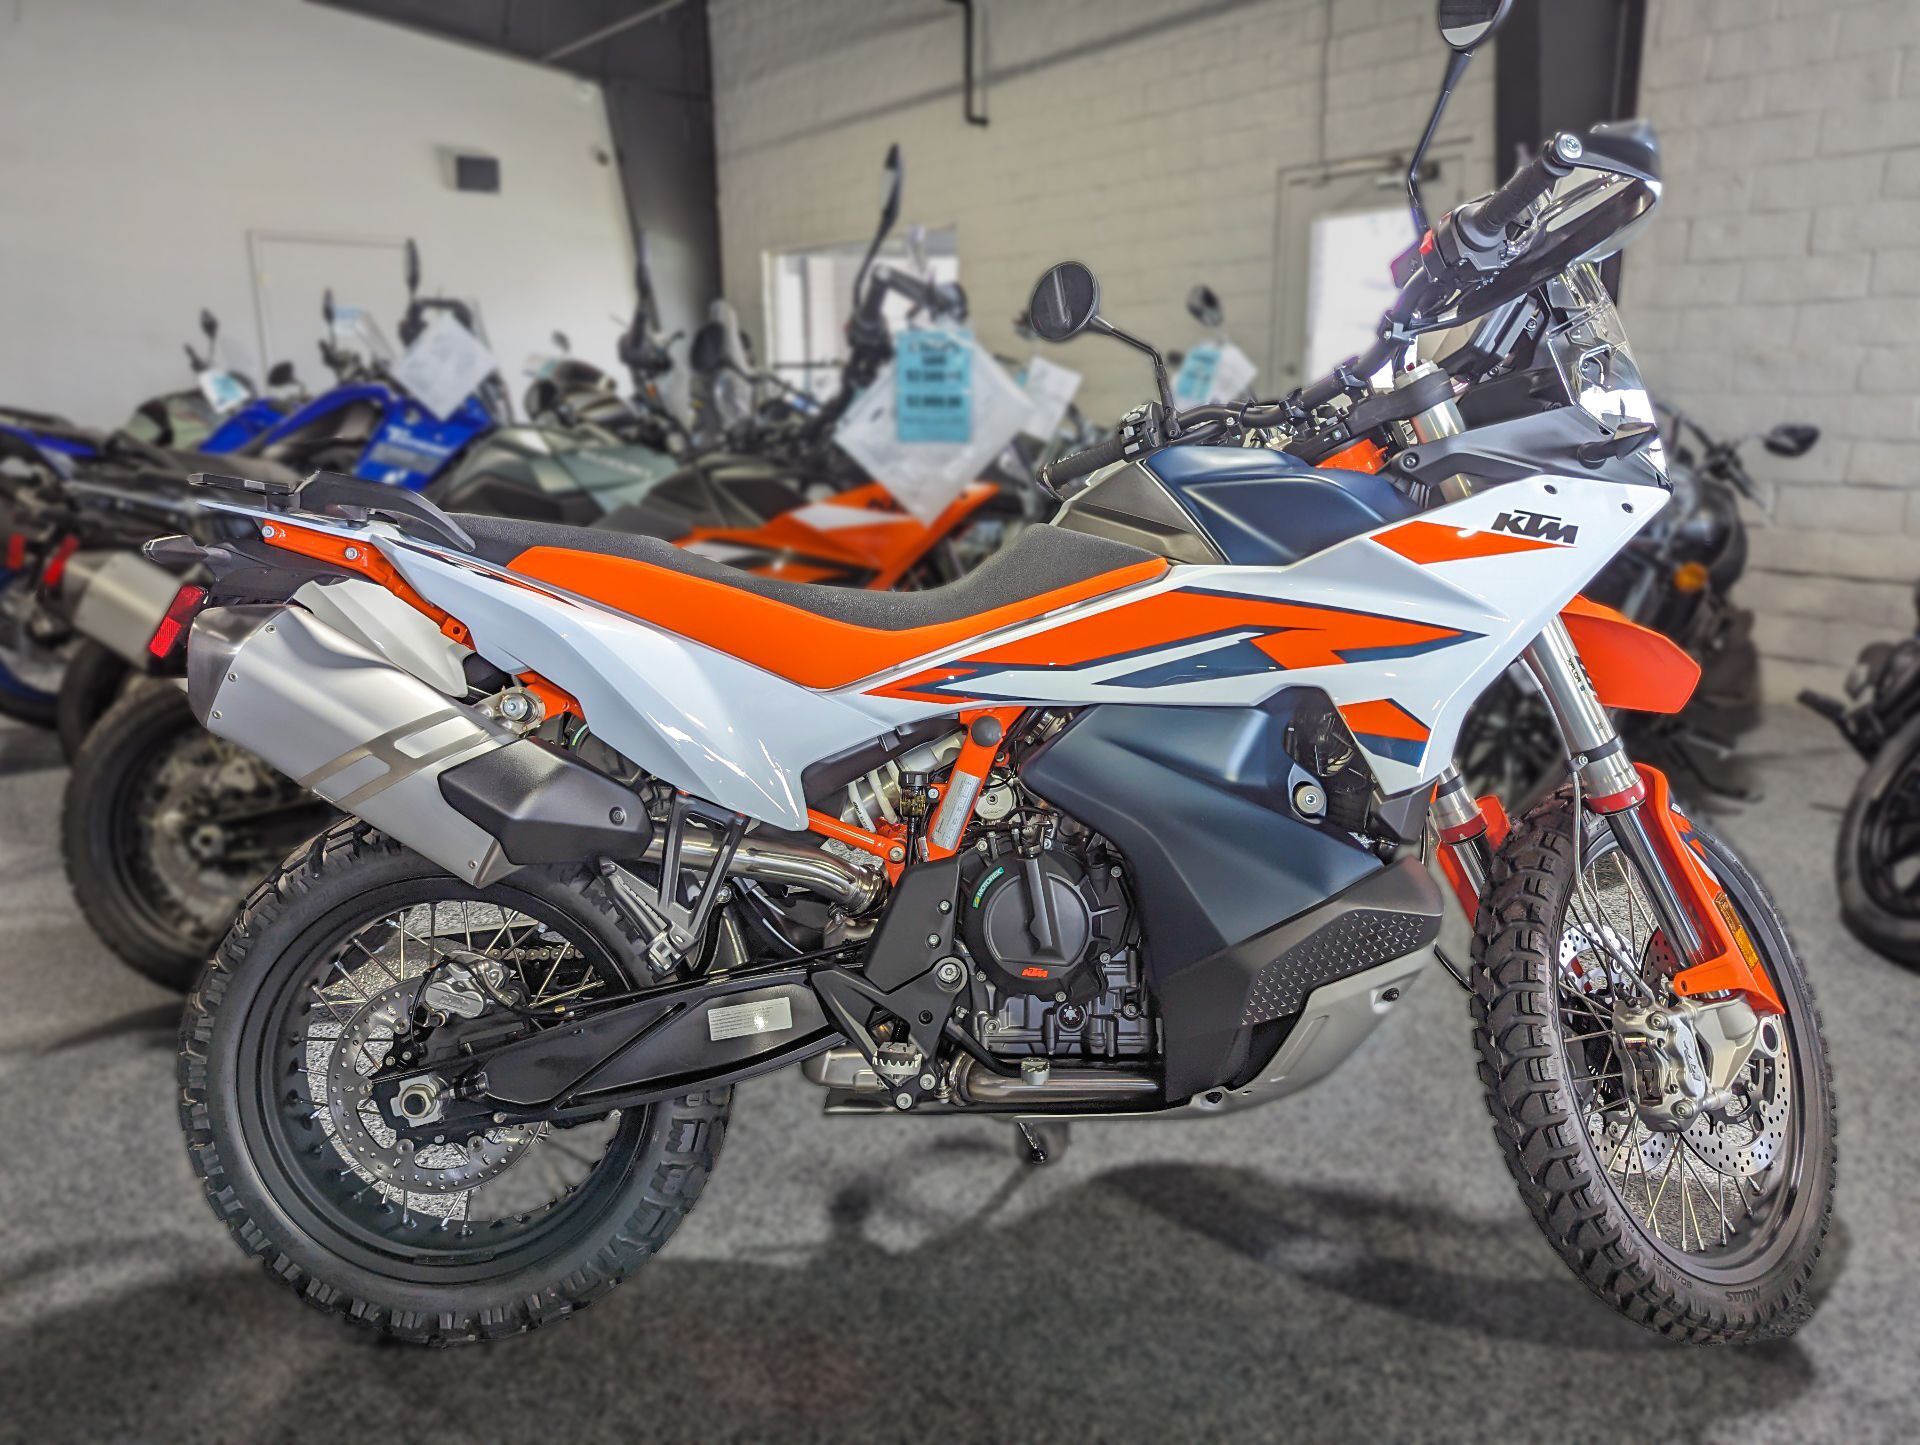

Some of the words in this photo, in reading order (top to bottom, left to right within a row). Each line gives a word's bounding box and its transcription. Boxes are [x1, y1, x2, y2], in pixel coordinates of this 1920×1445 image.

[1491, 509, 1579, 545] KTM
[977, 865, 1005, 898] MOTOREX
[1021, 967, 1049, 979] KTM
